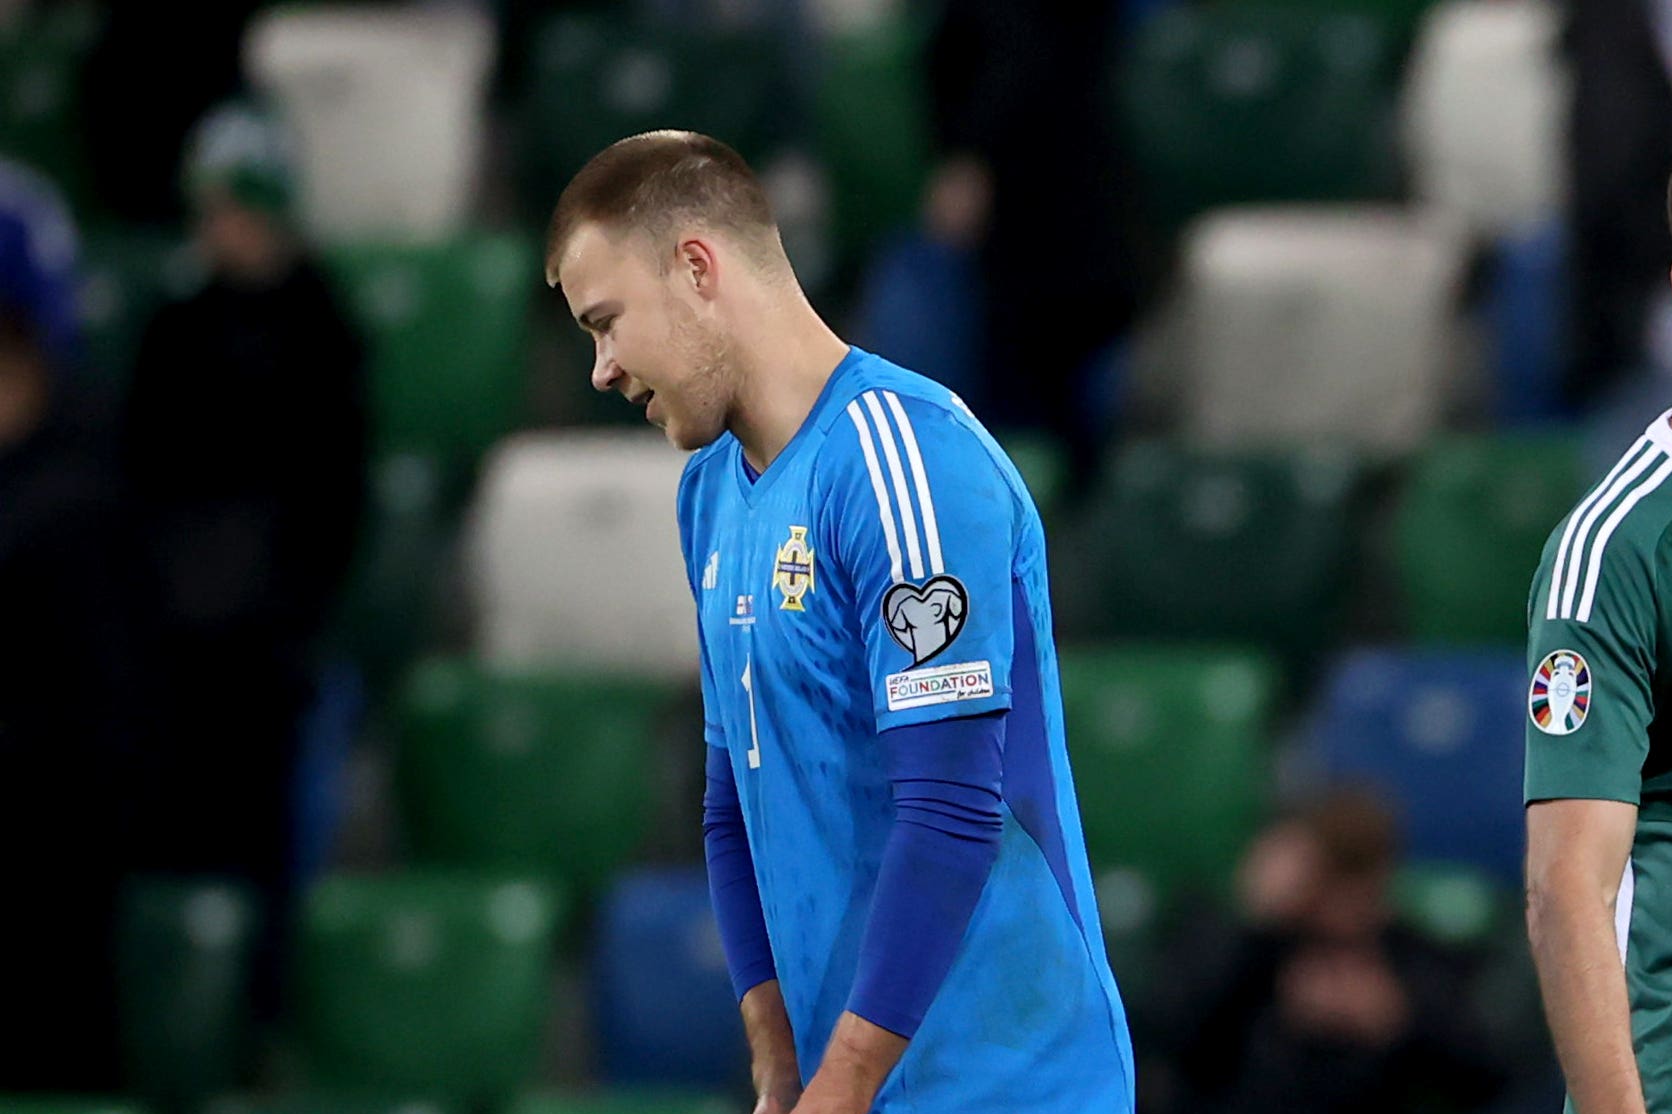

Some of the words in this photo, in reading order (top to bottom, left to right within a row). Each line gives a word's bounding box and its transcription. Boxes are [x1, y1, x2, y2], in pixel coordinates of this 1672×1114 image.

[890, 676, 909, 686] UEFA
[890, 673, 989, 698] FOUNDATION
[741, 653, 760, 769] 1
